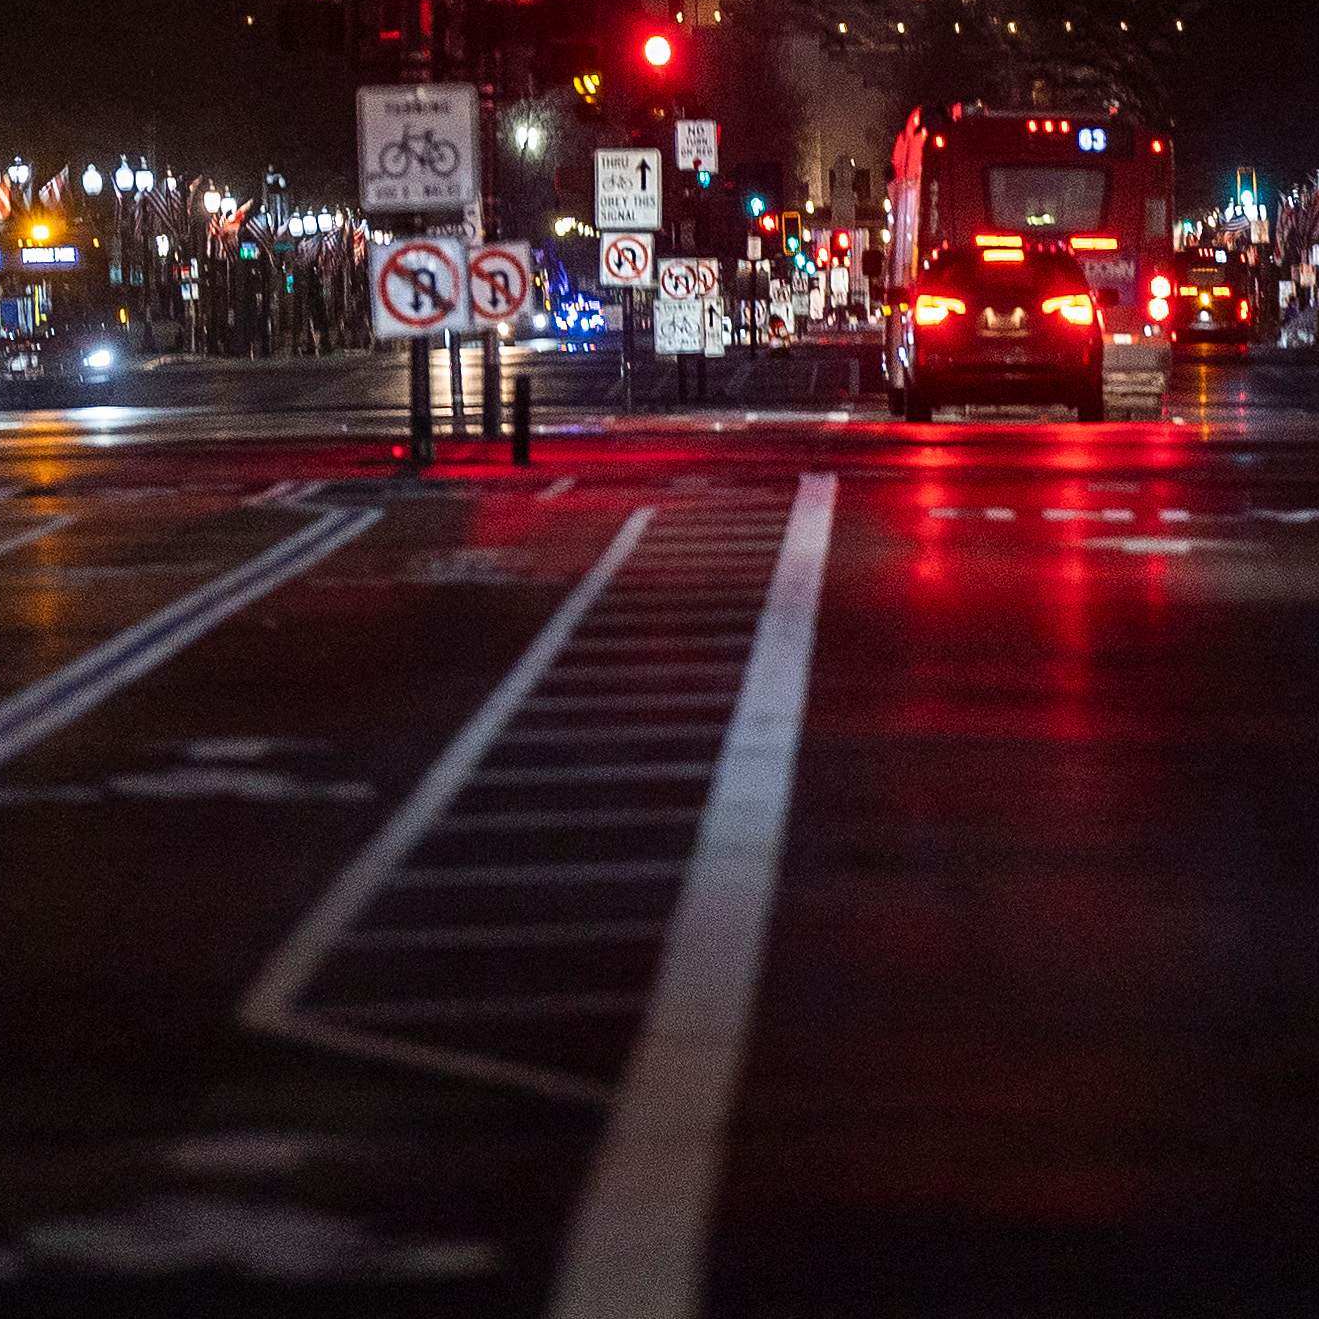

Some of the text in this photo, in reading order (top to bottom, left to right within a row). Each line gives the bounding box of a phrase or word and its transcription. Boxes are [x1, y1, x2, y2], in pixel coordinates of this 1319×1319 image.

[687, 125, 705, 136] NO
[601, 155, 629, 169] THRU
[600, 193, 656, 208] OBEY THIS
[600, 209, 635, 222] SIGNAL
